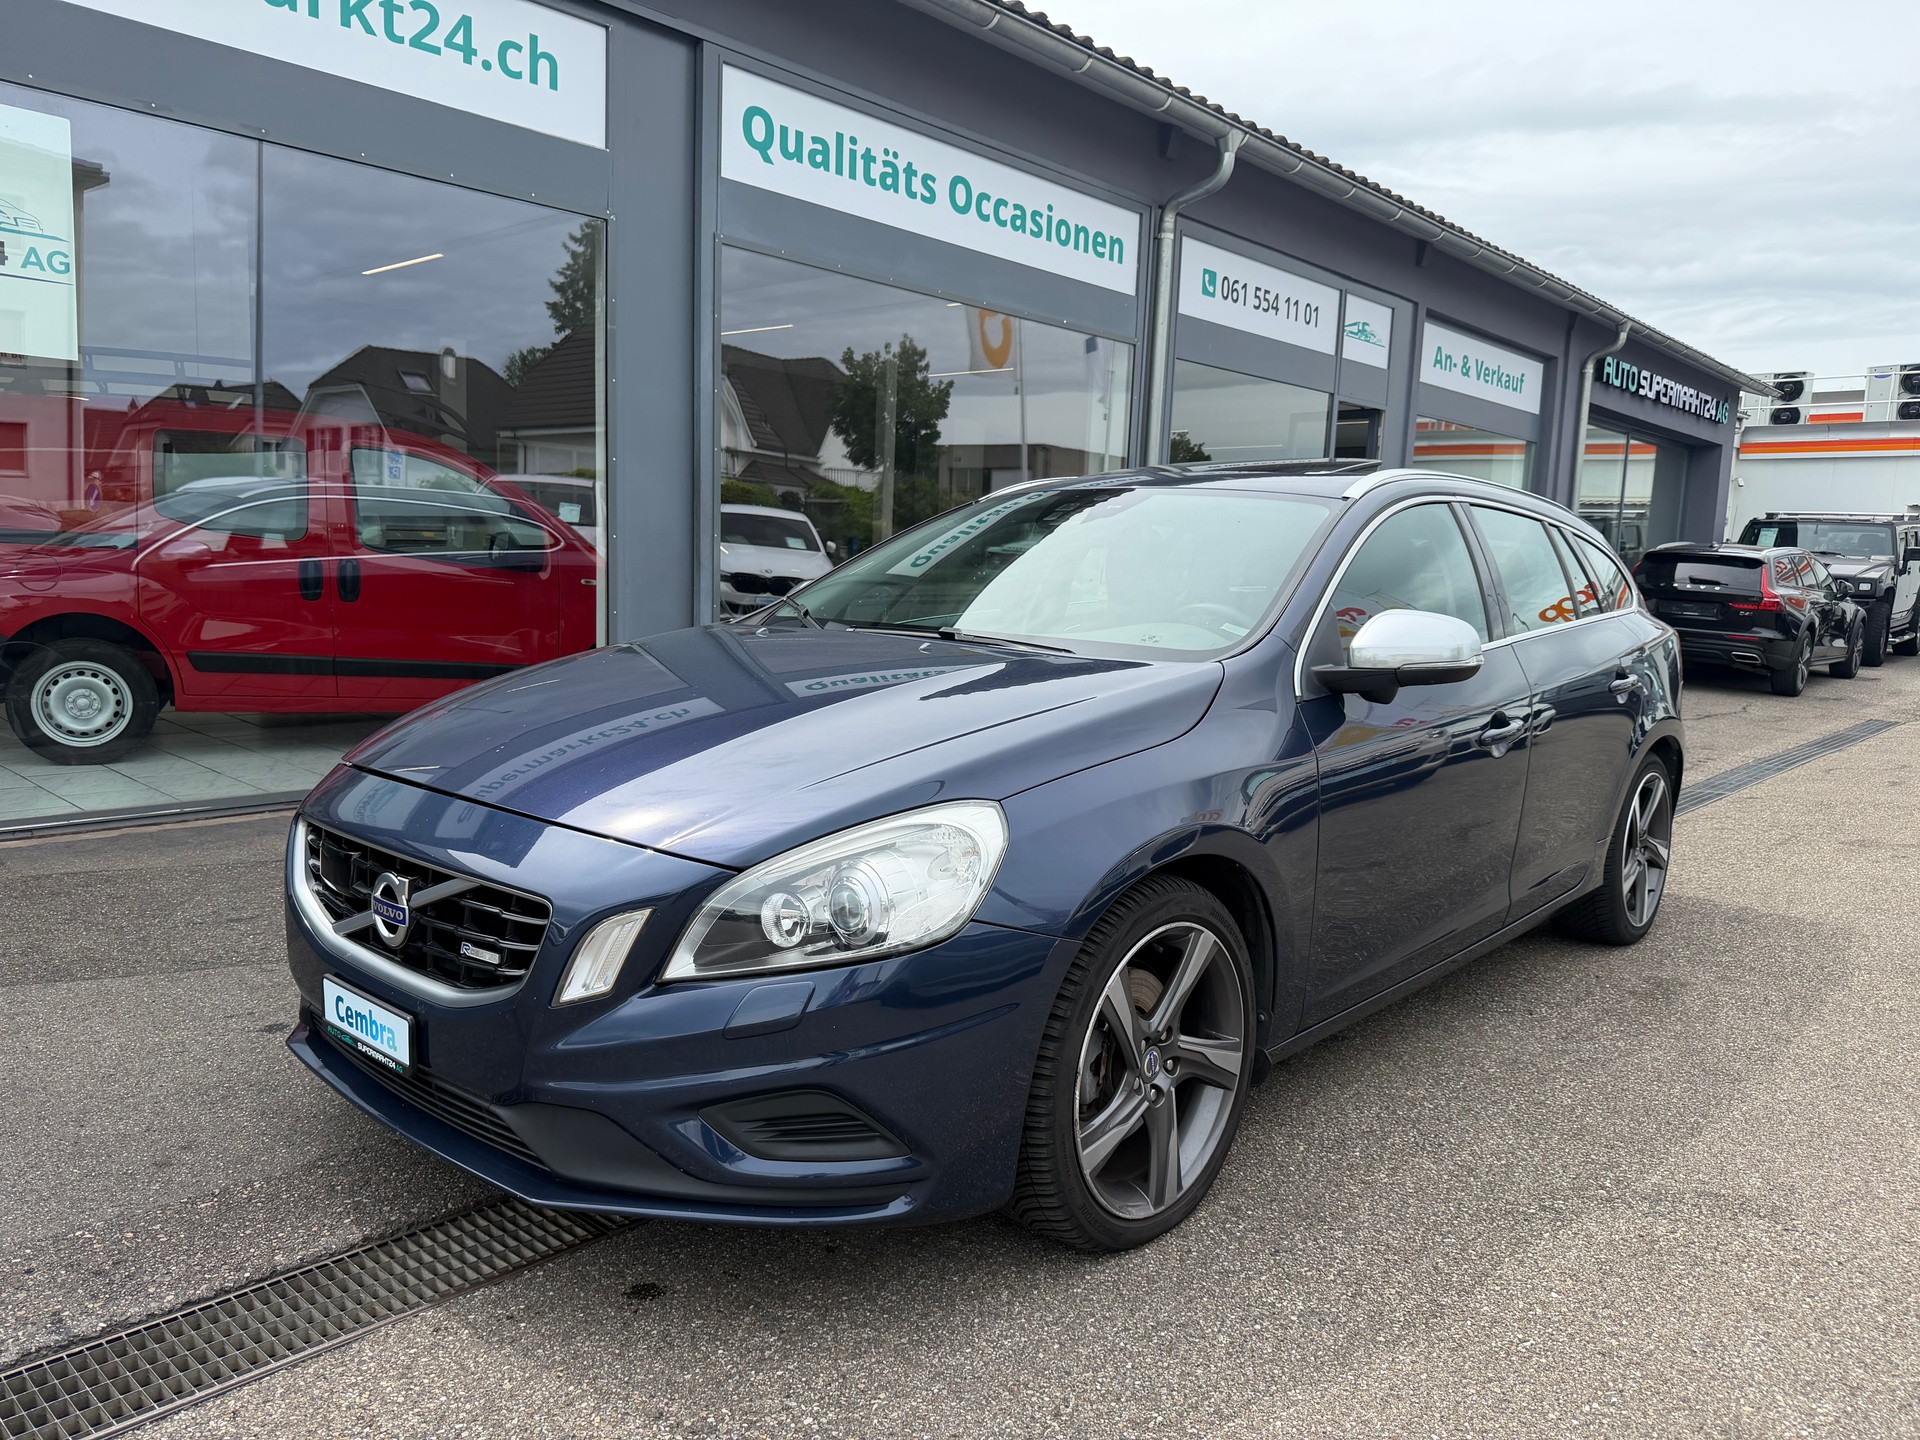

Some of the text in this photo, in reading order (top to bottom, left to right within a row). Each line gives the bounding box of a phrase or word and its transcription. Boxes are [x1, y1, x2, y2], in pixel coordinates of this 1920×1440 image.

[741, 105, 1125, 264] Qualitäts Occasionen
[20, 246, 71, 275] AG
[1221, 276, 1319, 328] 061 554 11 01
[1433, 346, 1525, 394] An- & Verkauf
[1603, 356, 1729, 424] AUTO SUPERMARKT24 AG
[373, 901, 404, 920] VOLVO
[327, 1025, 341, 1038] AUTO
[335, 994, 397, 1052] Cembra
